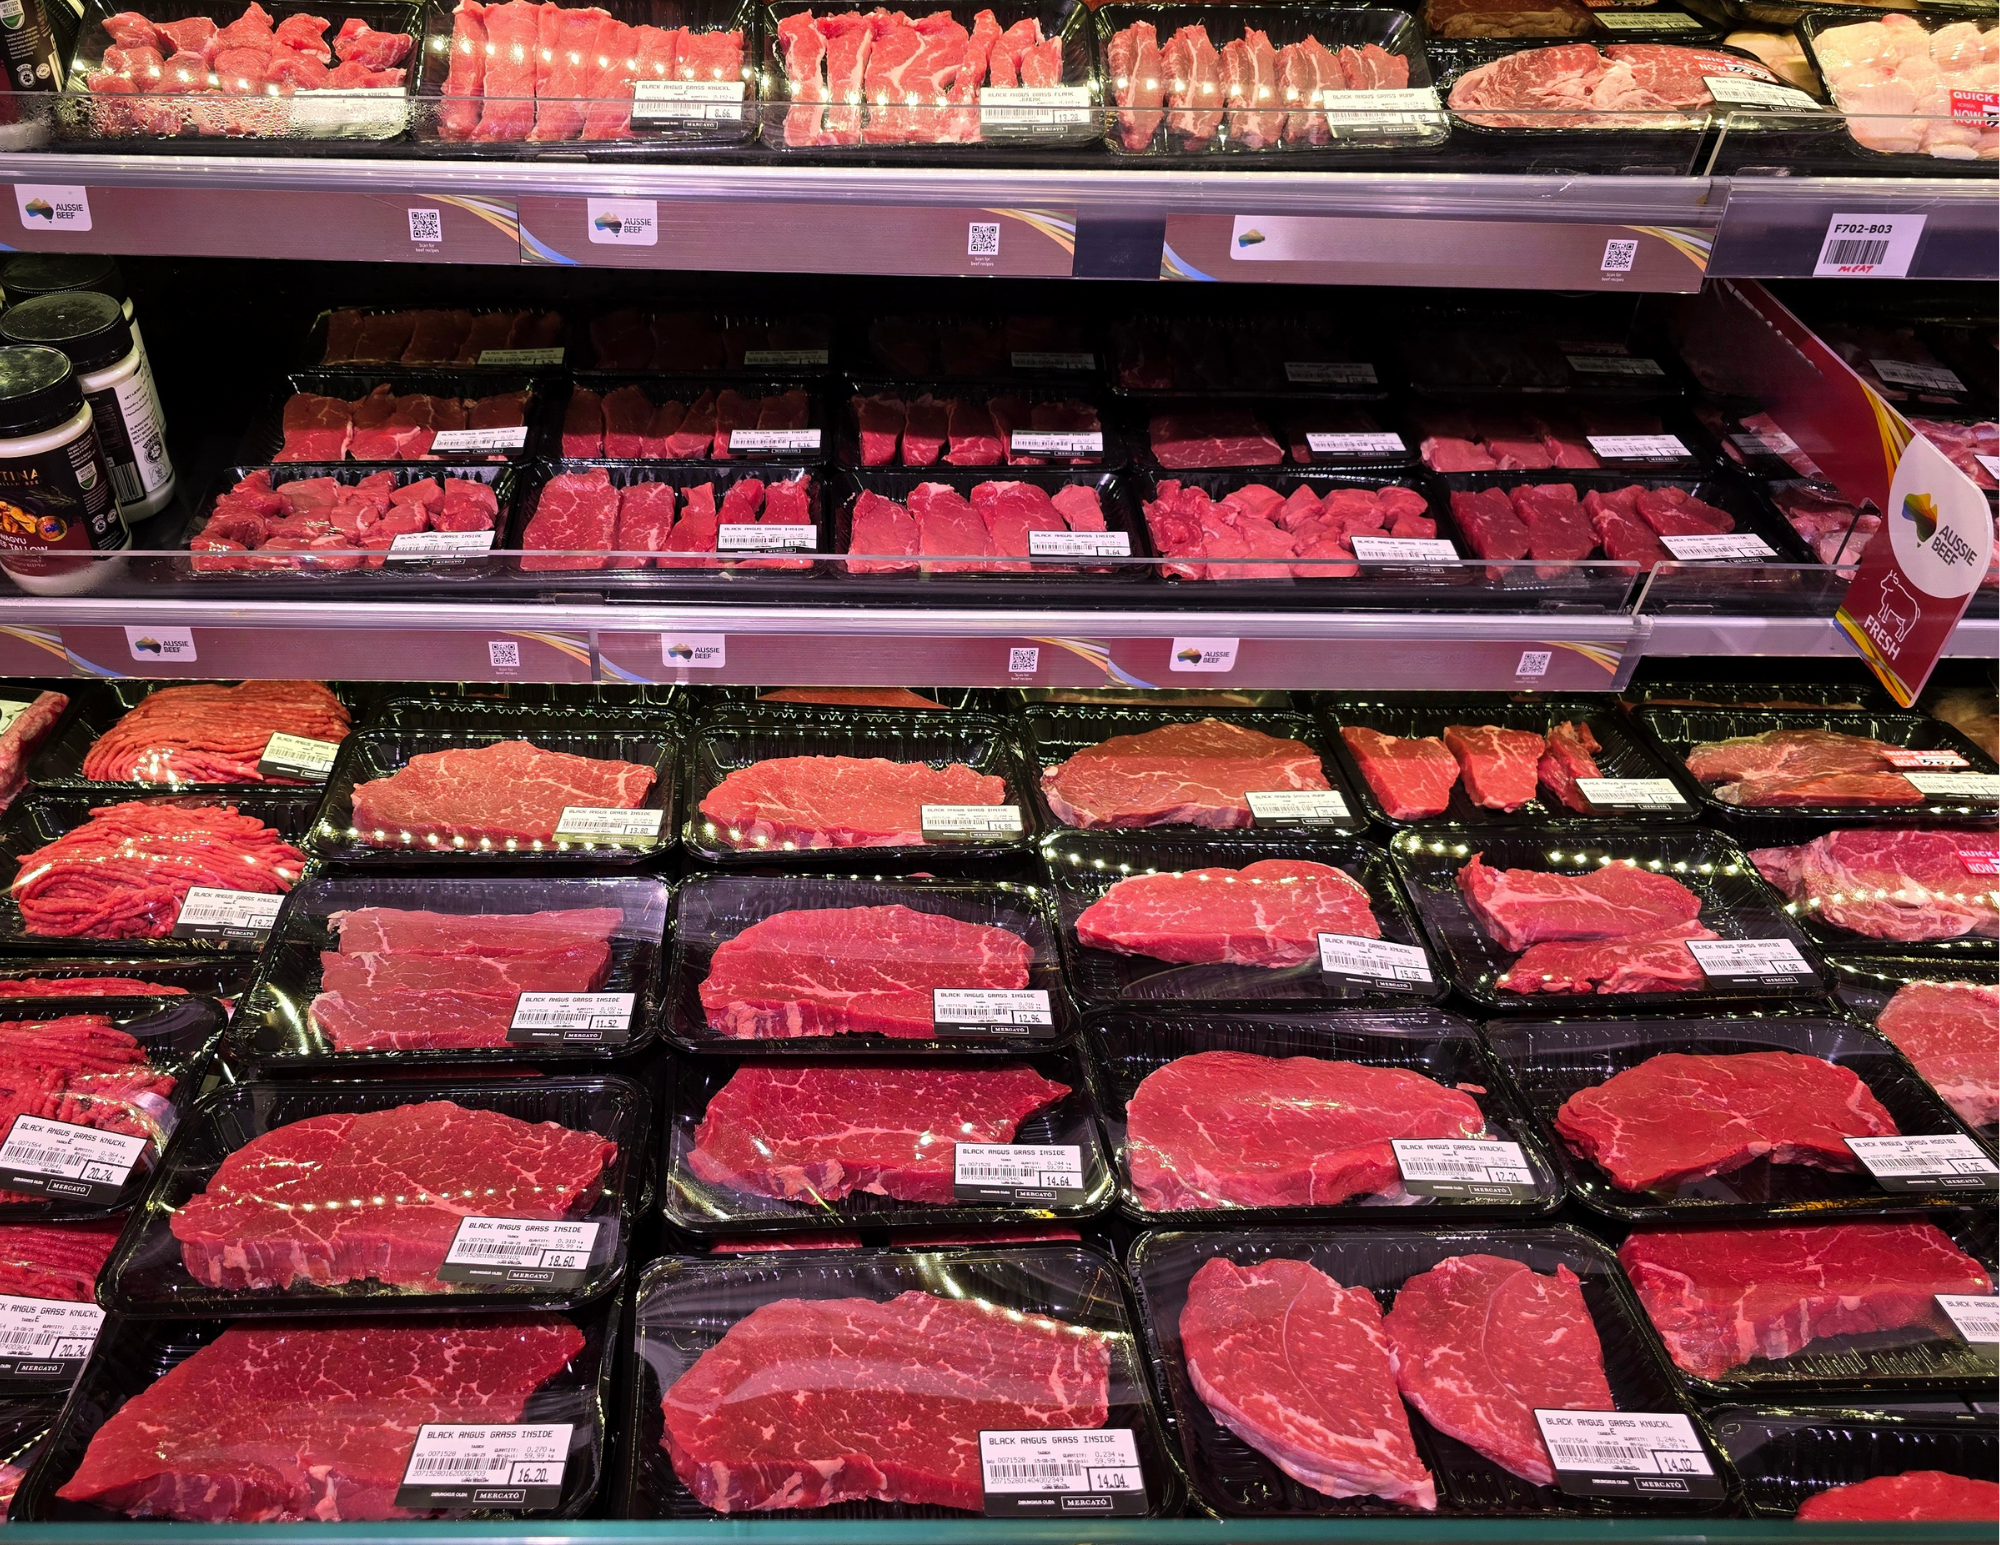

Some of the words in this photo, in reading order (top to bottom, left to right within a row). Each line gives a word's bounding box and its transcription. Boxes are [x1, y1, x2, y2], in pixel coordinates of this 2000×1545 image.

[1953, 91, 1994, 102] QUICK
[1953, 109, 1981, 125] NOW
[55, 203, 84, 212] AUSSIE
[56, 211, 75, 219] BEEF
[624, 218, 652, 226] AUSSIE
[1834, 224, 1892, 233] F702-B03
[1938, 525, 1977, 567] AUSSIE
[1931, 540, 1959, 566] BEEF
[1863, 614, 1901, 661] FRESH
[1967, 863, 1995, 872] NOW
[20, 1123, 44, 1132] BLACK
[46, 1127, 71, 1136] ANGUS
[74, 1132, 97, 1142] GRASS
[100, 1137, 126, 1148] KNUCKL
[1046, 1176, 1072, 1186] 14.64
[548, 1255, 575, 1267] 18.60
[10, 1304, 36, 1313] ANGUS
[40, 1307, 66, 1316] GRASS
[69, 1309, 99, 1318] KNUCKL
[1546, 1417, 1573, 1426] BLACK
[1577, 1419, 1605, 1427] ANGUS
[1609, 1419, 1636, 1428] GRASS
[1639, 1420, 1673, 1429] KNUCKL
[427, 1431, 454, 1439] BLACK
[522, 1430, 554, 1438] INSIDE
[989, 1437, 1016, 1445] BLACK
[1083, 1435, 1115, 1443] INSIDE
[517, 1468, 549, 1483] 16.20
[1097, 1473, 1130, 1489] 14.04
